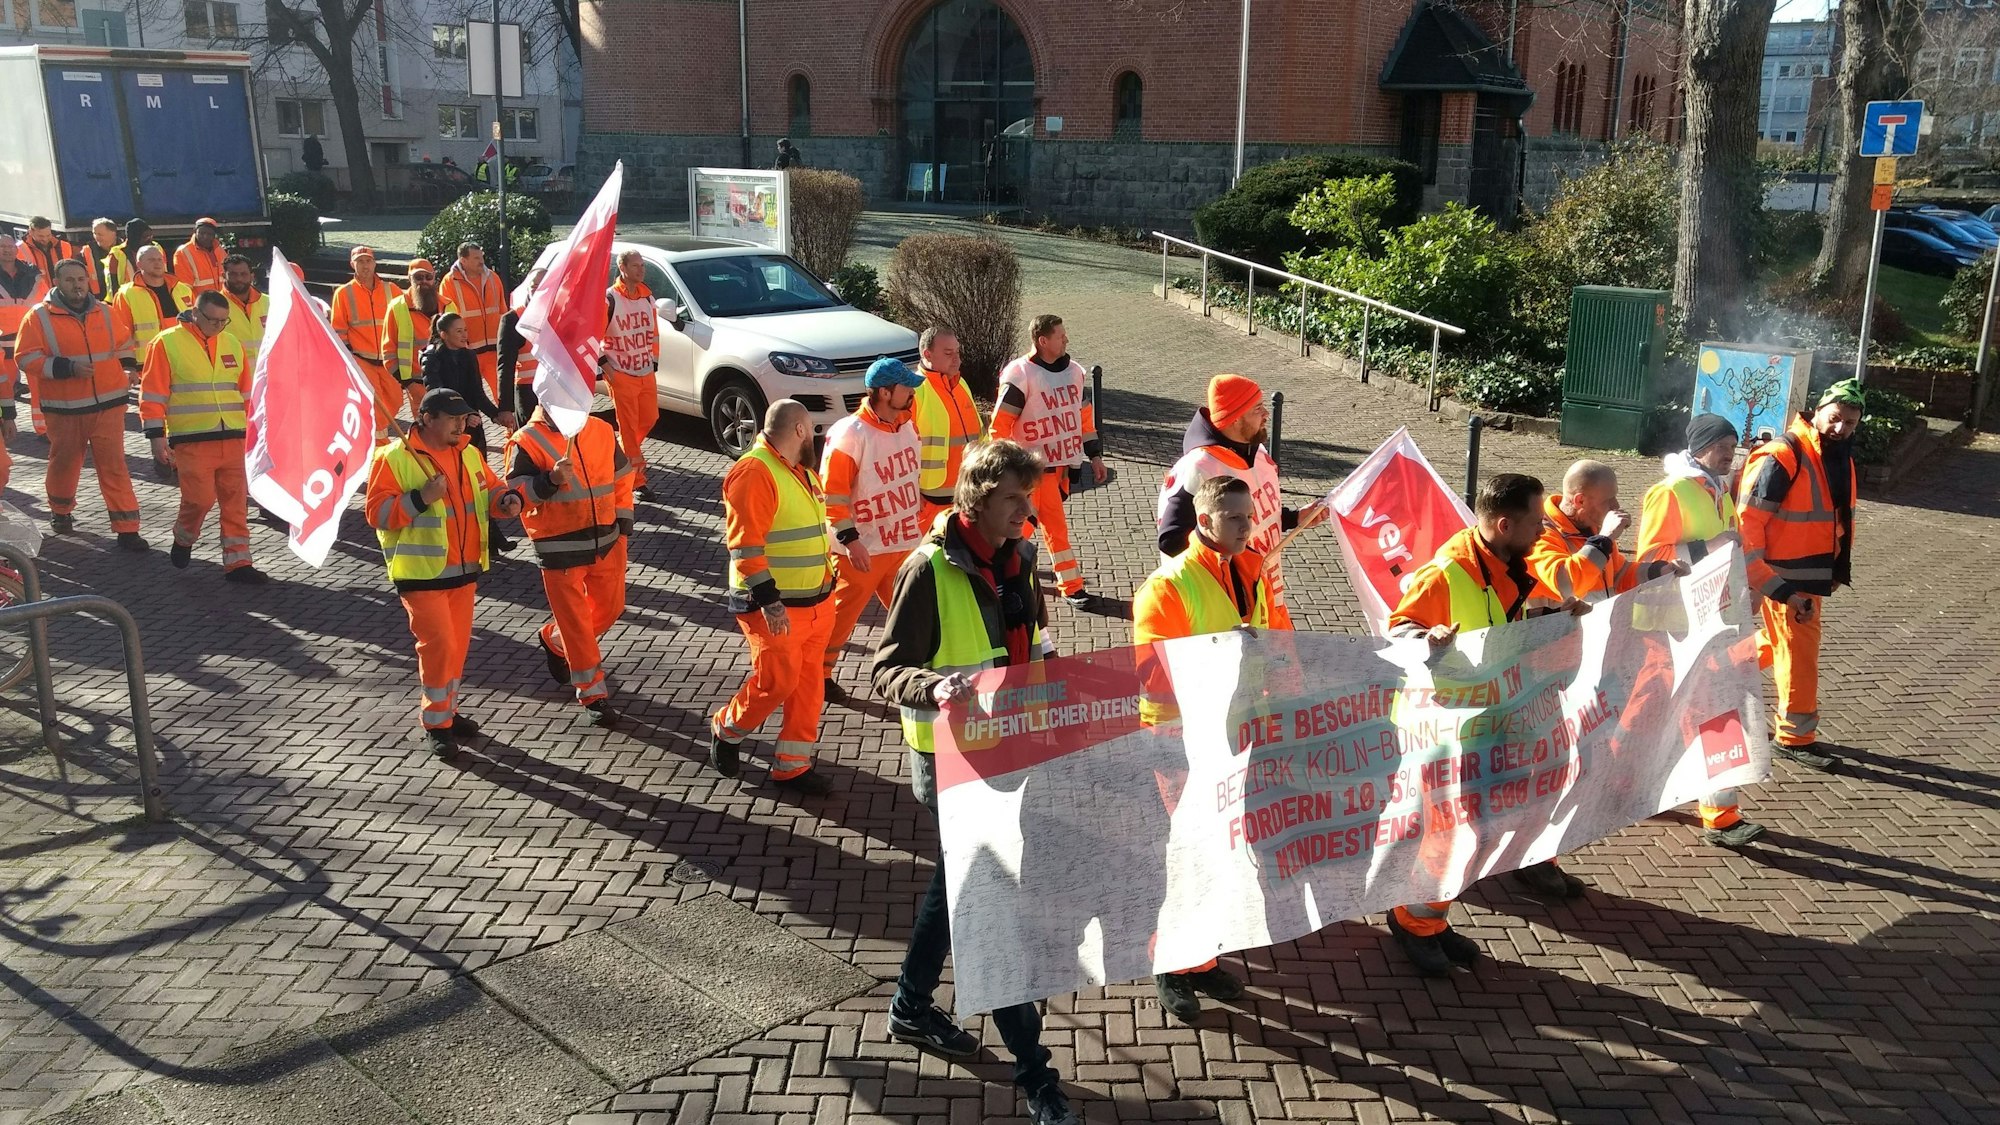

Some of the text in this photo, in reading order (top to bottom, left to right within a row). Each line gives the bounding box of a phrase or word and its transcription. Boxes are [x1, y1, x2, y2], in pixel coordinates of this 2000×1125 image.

[79, 93, 92, 108] R
[146, 95, 162, 109] M
[209, 96, 219, 109] L
[615, 310, 651, 331] WIR
[1040, 384, 1080, 410] WIR
[1022, 410, 1078, 442] SIND
[873, 446, 919, 485] WIR
[853, 481, 918, 523] SIND
[968, 680, 1068, 716] TARIFRUNDE
[1239, 713, 1284, 754] DIE
[1295, 677, 1500, 739] BESCHÄFTIGTEN
[964, 703, 1089, 742] ÖFFENTLICHER
[1216, 676, 1568, 813] BEZIRK KÖLN-BONN-LEVERKUSEN
[1229, 790, 1332, 850] FORDERN
[1420, 751, 1481, 793] MEHR
[1489, 738, 1548, 775] GELD
[1551, 716, 1580, 758] FÜR
[1274, 811, 1421, 881] MINDESTENS
[1431, 792, 1482, 835] ABER
[1489, 777, 1529, 814] 500
